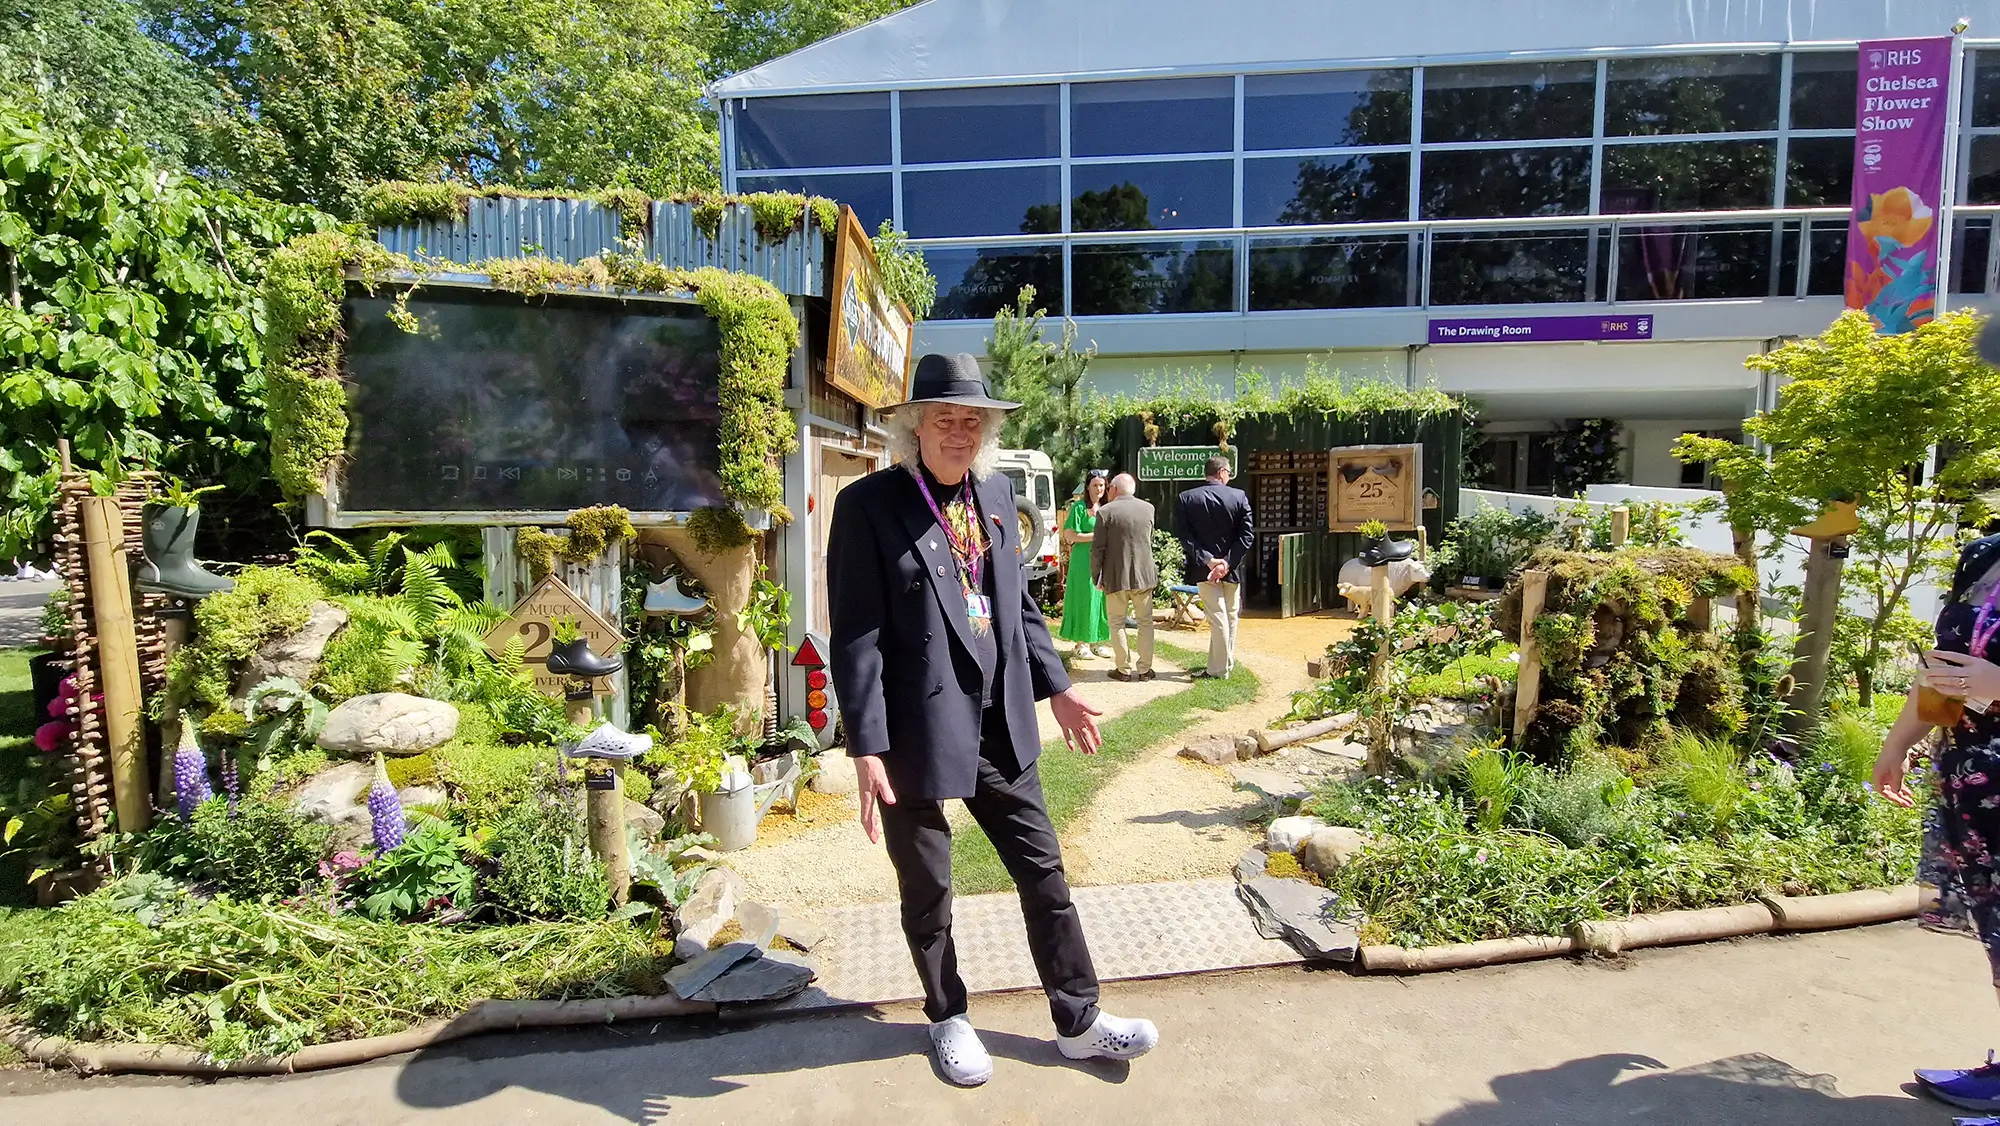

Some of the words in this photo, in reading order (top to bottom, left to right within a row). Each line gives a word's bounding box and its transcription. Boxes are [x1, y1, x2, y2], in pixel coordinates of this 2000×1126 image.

[1887, 49, 1922, 66] RHS
[1866, 75, 1938, 92] Chelsea
[1863, 96, 1931, 112] Flower
[1861, 115, 1914, 132] Show
[1438, 326, 1457, 337] The
[1458, 325, 1501, 338] Drawing
[1502, 325, 1532, 336] Room
[1610, 322, 1628, 332] RHS
[1151, 450, 1206, 462] Welcome
[1141, 465, 1159, 477] the
[1163, 465, 1184, 476] Isle
[1186, 464, 1200, 476] of
[1360, 482, 1384, 499] 25
[529, 603, 572, 615] MUCK
